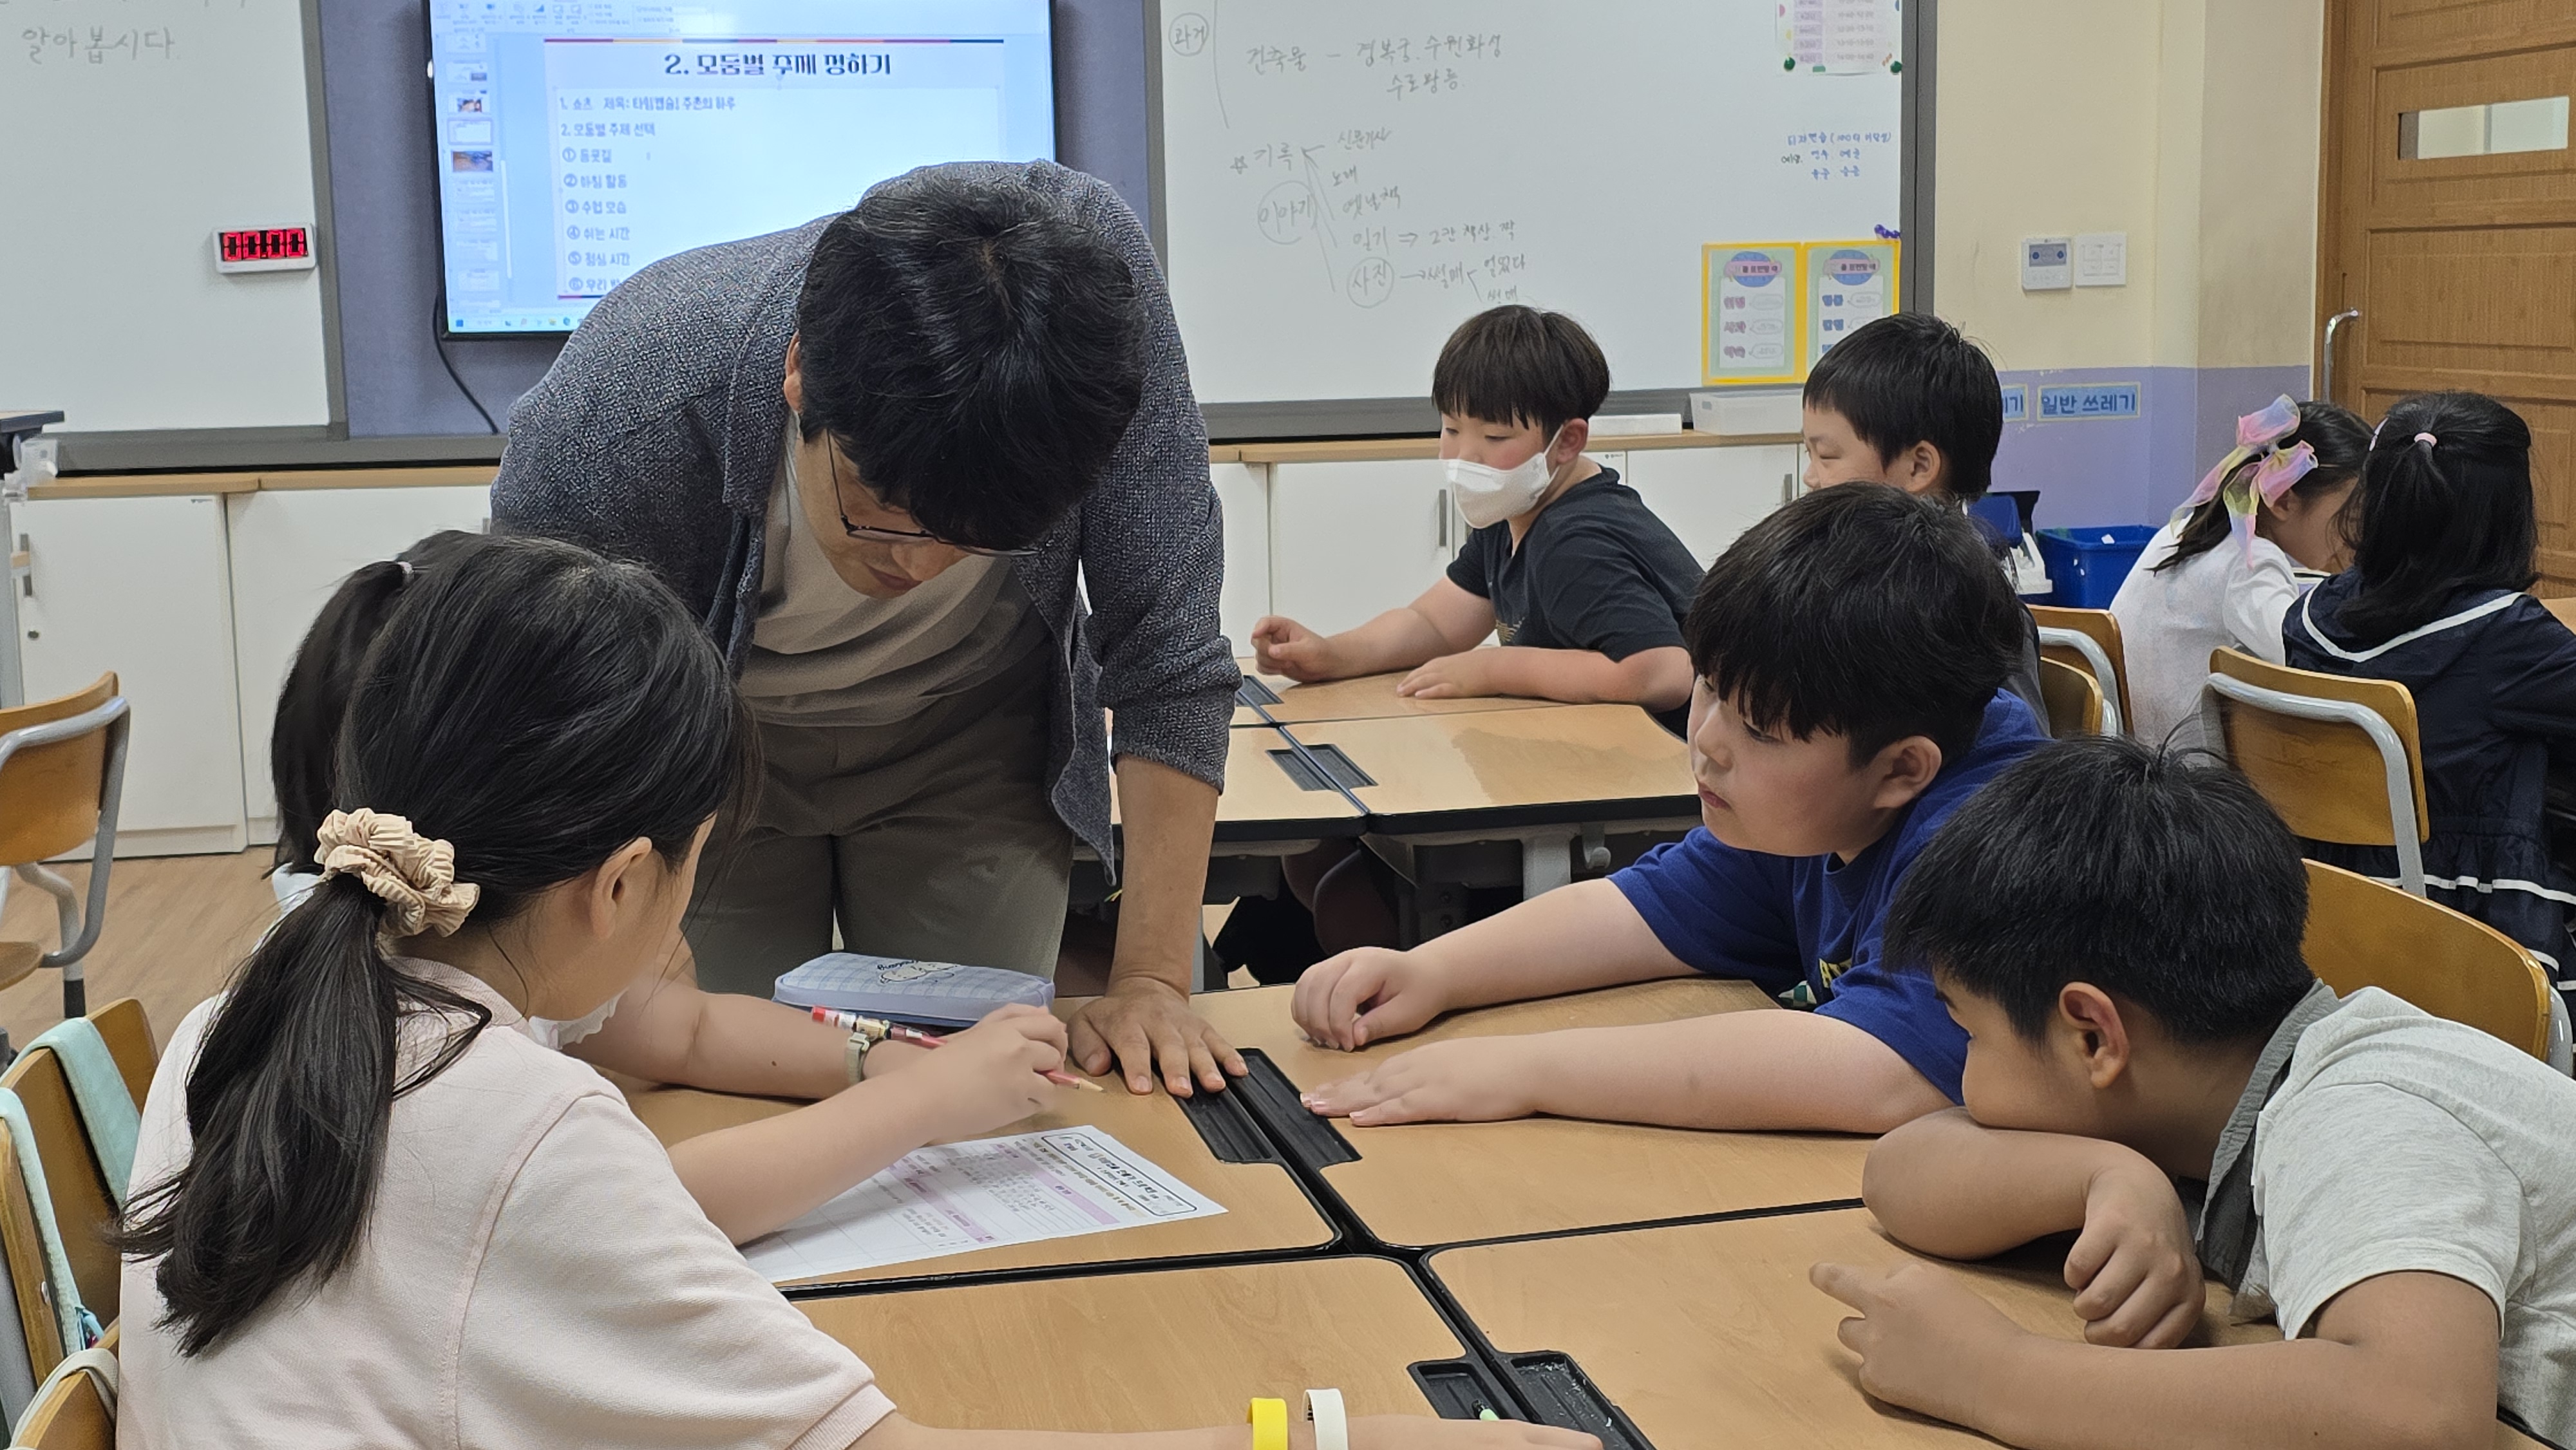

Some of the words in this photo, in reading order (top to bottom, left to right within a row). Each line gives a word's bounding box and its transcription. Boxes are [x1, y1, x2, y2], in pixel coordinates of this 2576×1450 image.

[1246, 44, 1307, 75] 건축물
[1424, 33, 1501, 61] 수원화성
[664, 53, 689, 75] 2.
[696, 53, 764, 75] 모둠별
[772, 53, 817, 75] 주제
[823, 53, 891, 75] 정하기
[715, 97, 735, 111] 하루
[560, 123, 571, 137] 2.
[574, 122, 607, 137] 모둠별
[609, 122, 630, 137] 주제
[634, 122, 656, 137] 선택
[580, 148, 612, 163] 등굣길
[1253, 142, 1293, 171] 기록
[580, 174, 602, 189] 아침
[605, 174, 628, 189] 활동
[582, 200, 603, 215] 수업
[605, 201, 627, 214] 모습
[1259, 194, 1311, 235] 이야기
[583, 227, 605, 241] 쉬는
[609, 227, 630, 241] 시간
[1353, 227, 1389, 255] 일기
[585, 252, 607, 267] 점심
[609, 252, 630, 266] 시간
[586, 278, 607, 292] 우리
[1352, 261, 1385, 296] 사진
[2041, 394, 2077, 415] 일반
[2082, 393, 2136, 411] 쓰레기
